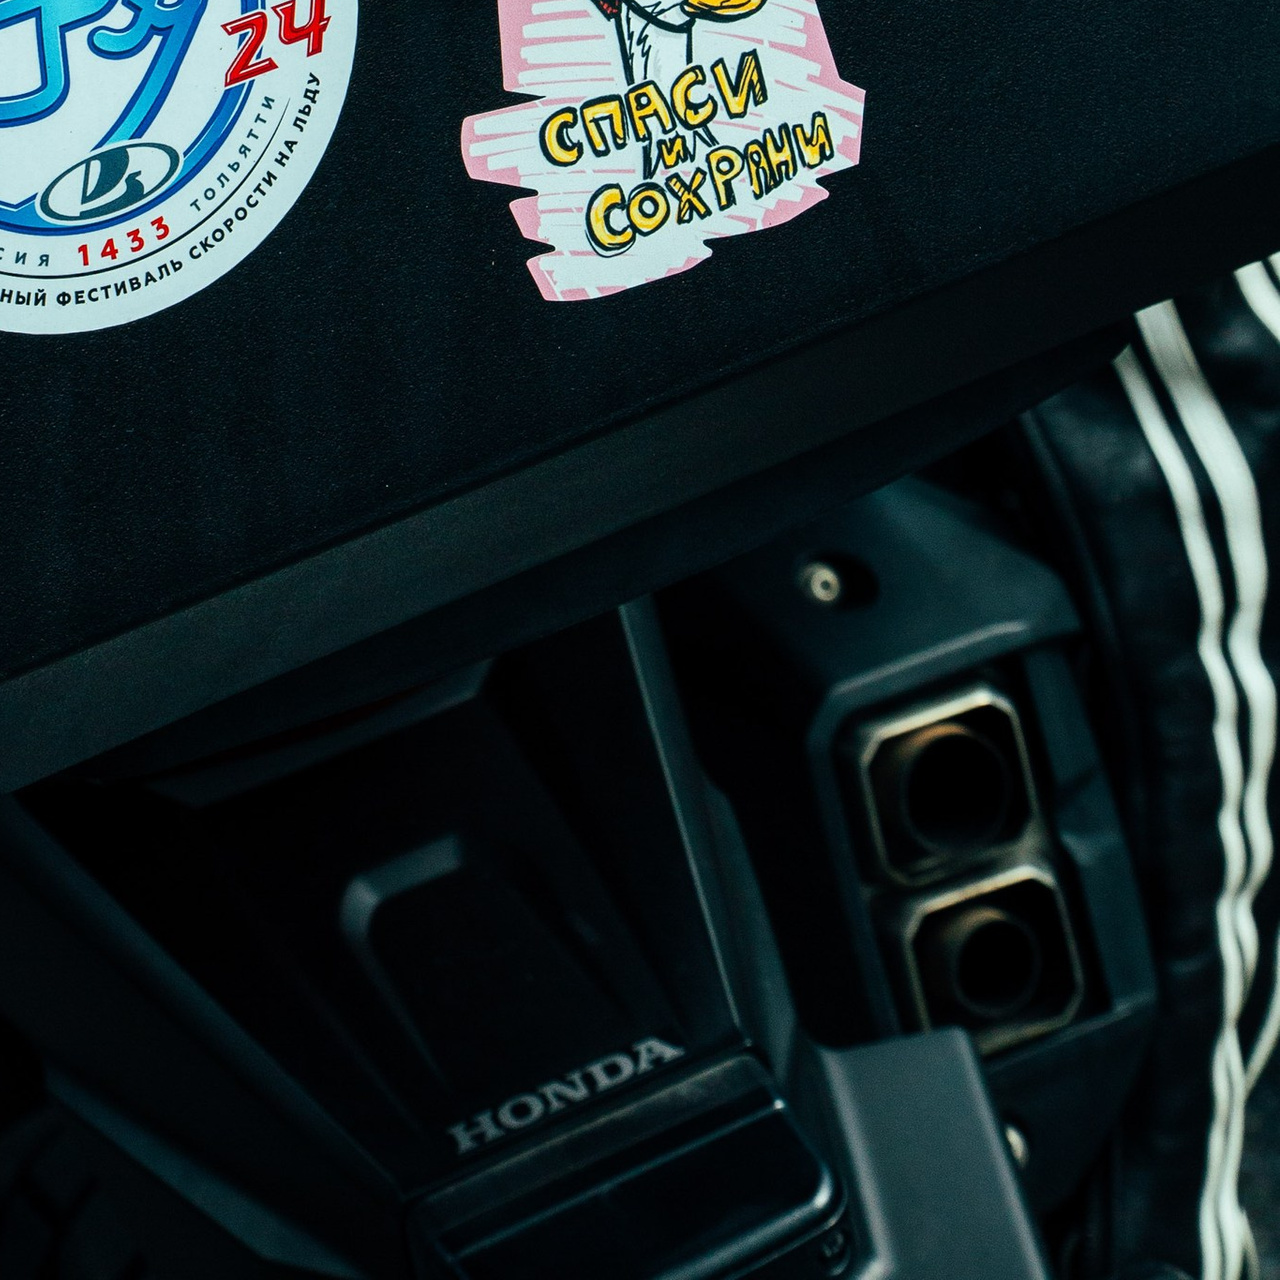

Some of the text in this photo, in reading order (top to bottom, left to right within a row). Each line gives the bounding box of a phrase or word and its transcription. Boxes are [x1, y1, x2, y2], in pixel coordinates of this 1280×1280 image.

[539, 48, 768, 167] СПАСИ
[56, 259, 183, 307] ФЕСТИВАЛЬ
[189, 170, 278, 259] СКОРОСТИ
[274, 138, 298, 168] НА
[292, 72, 320, 132] ЛЬДУ
[77, 216, 170, 266] 1433
[190, 96, 275, 212] ТОЛЬЯТТИ
[586, 111, 835, 252] СОХРАНИ
[448, 1036, 685, 1154] HONDA
